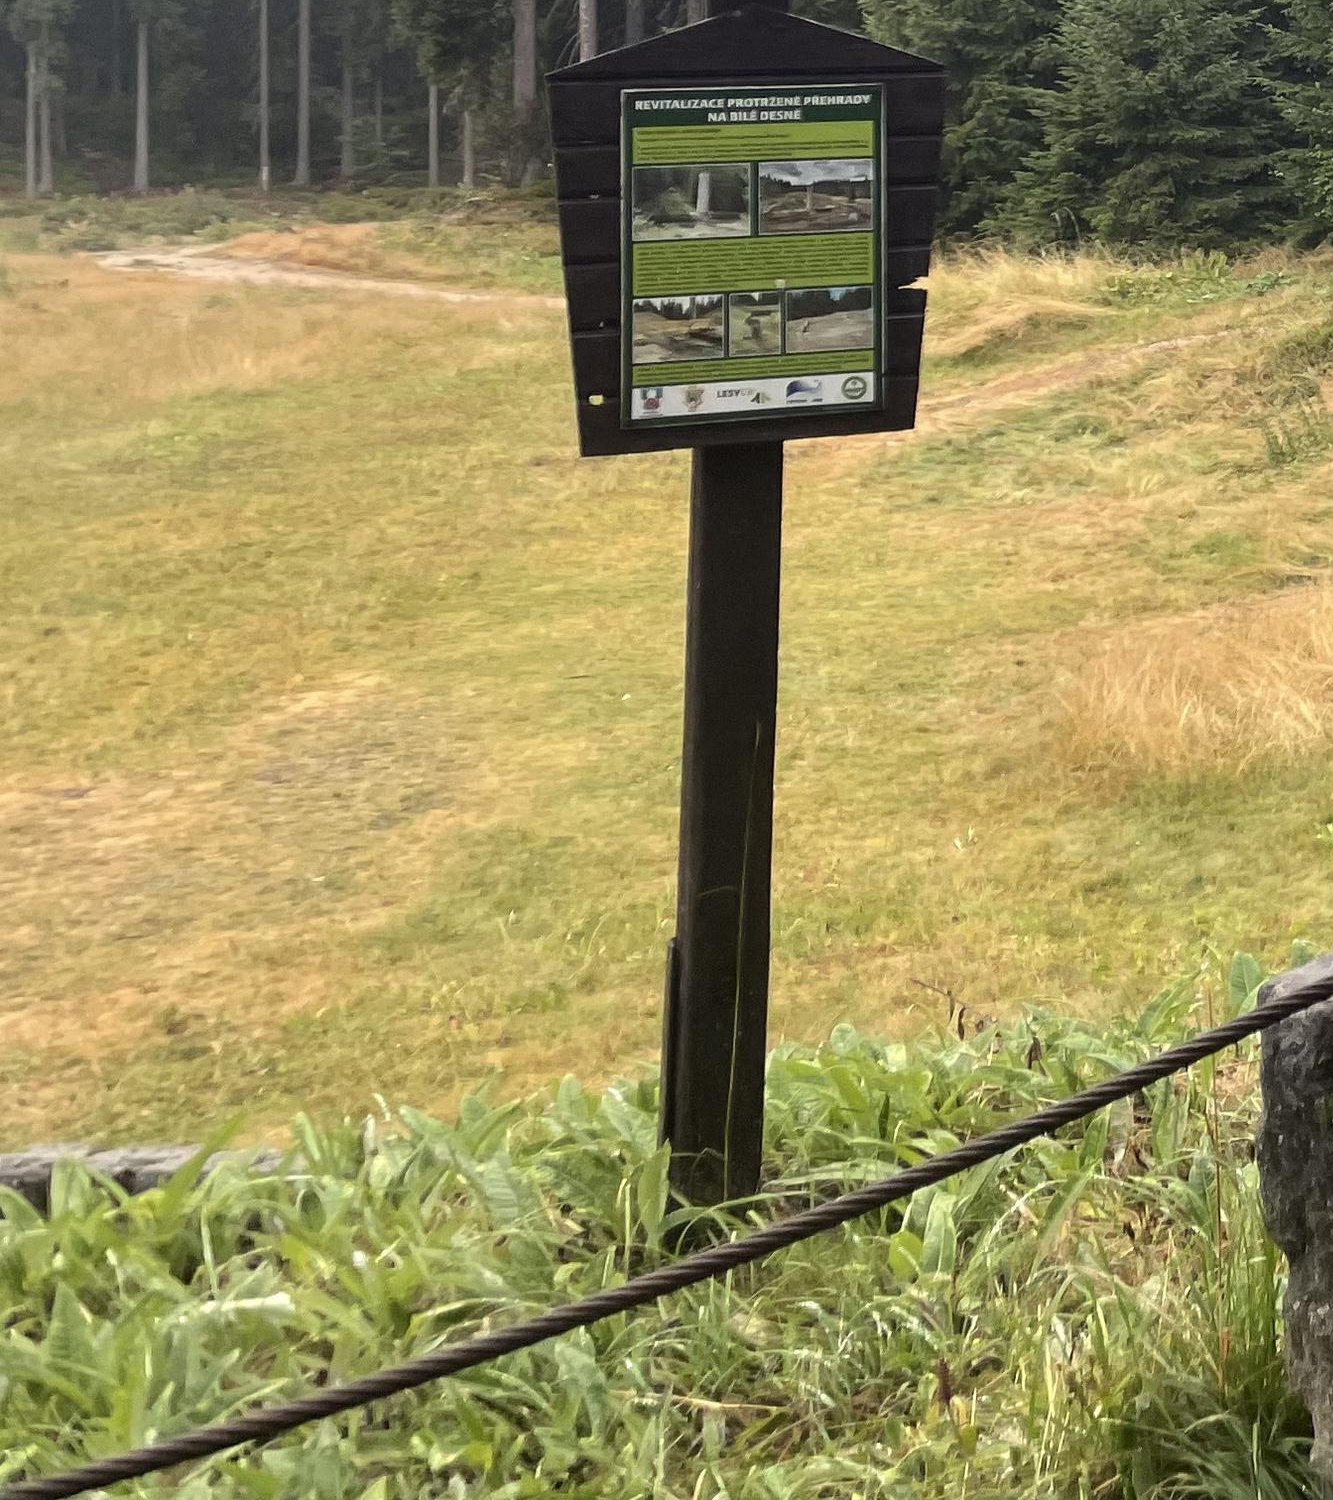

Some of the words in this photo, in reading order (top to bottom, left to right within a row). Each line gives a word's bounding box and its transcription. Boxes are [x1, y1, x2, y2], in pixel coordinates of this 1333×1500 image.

[635, 98, 725, 111] REVITALIZACE
[727, 95, 801, 109] PROTRŽENÉ
[803, 93, 873, 106] PŘEHRADY
[707, 112, 726, 122] NA
[729, 110, 757, 121] BÍLÉ
